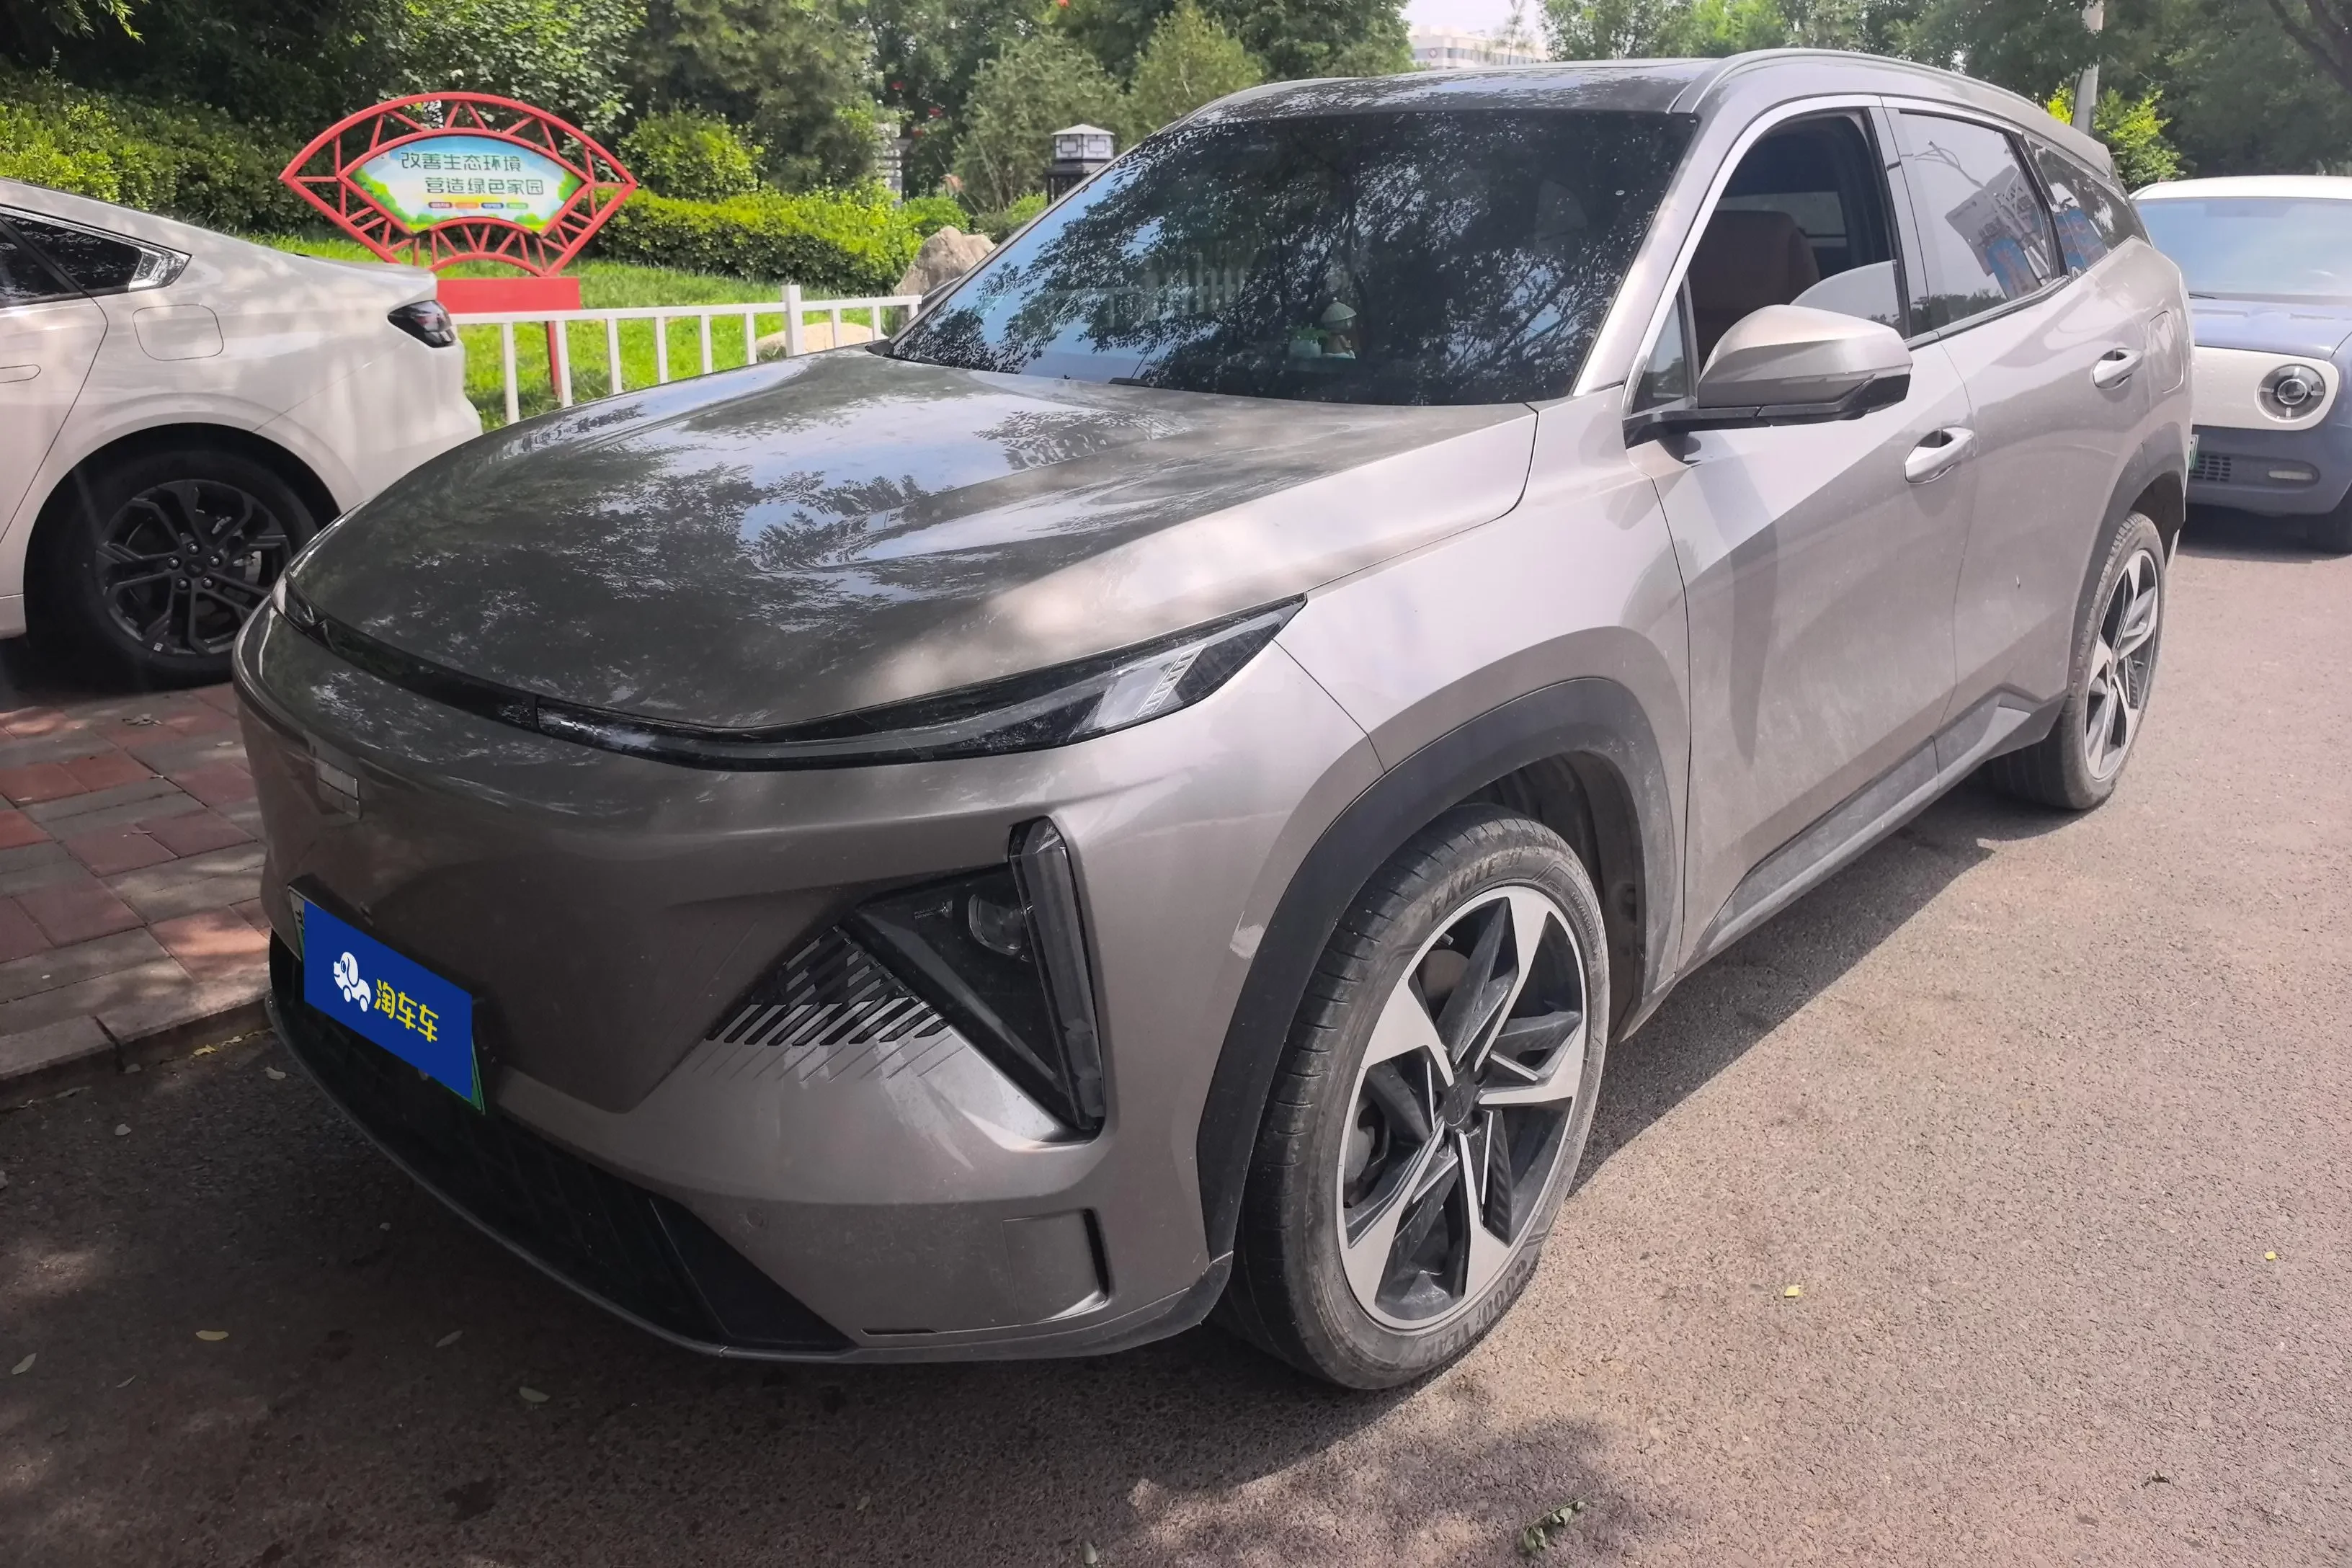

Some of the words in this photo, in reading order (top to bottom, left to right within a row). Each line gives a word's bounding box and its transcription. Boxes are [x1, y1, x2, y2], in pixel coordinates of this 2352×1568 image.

[401, 152, 521, 172] 改善生态环境
[425, 177, 544, 195] 营造绿色家园
